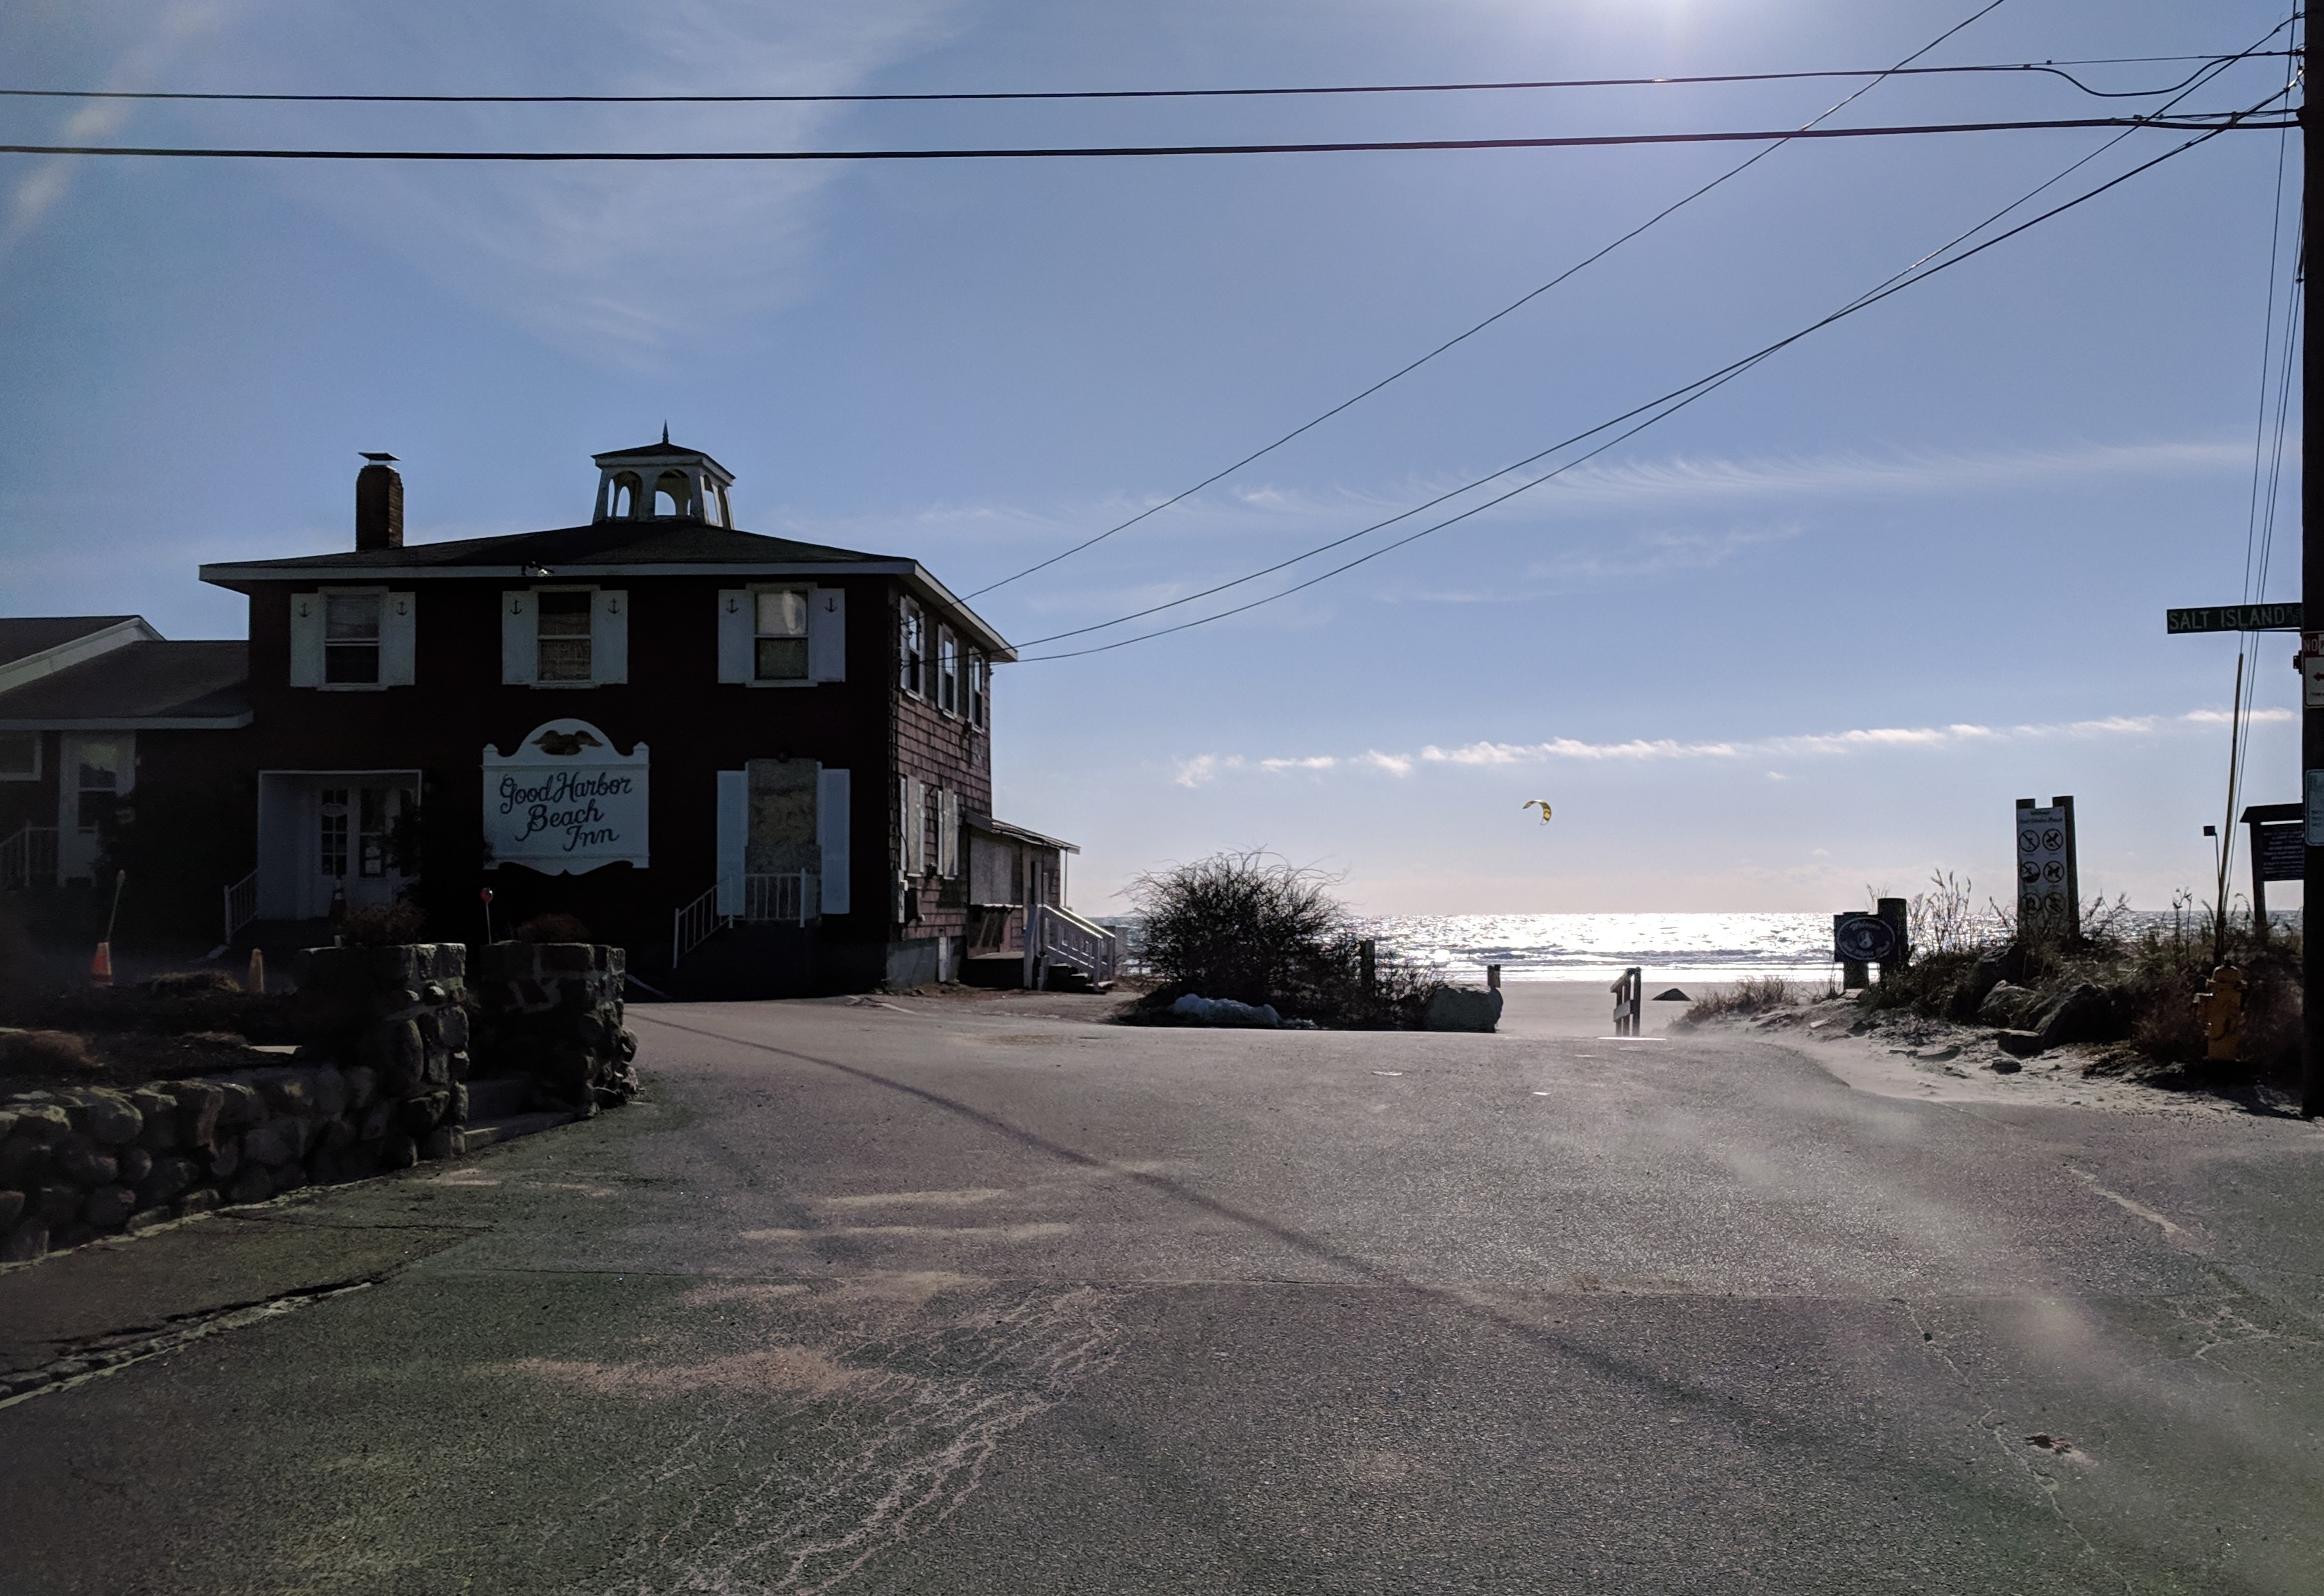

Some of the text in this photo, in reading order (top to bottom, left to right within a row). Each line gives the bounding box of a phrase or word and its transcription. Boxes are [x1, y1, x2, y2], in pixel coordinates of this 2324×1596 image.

[2168, 611, 2210, 630] SALT
[2221, 607, 2285, 628] ISLAND
[2302, 638, 2318, 653] NO
[500, 771, 632, 814] Good Harbor
[515, 798, 604, 841] Beach
[562, 825, 620, 852] Inn
